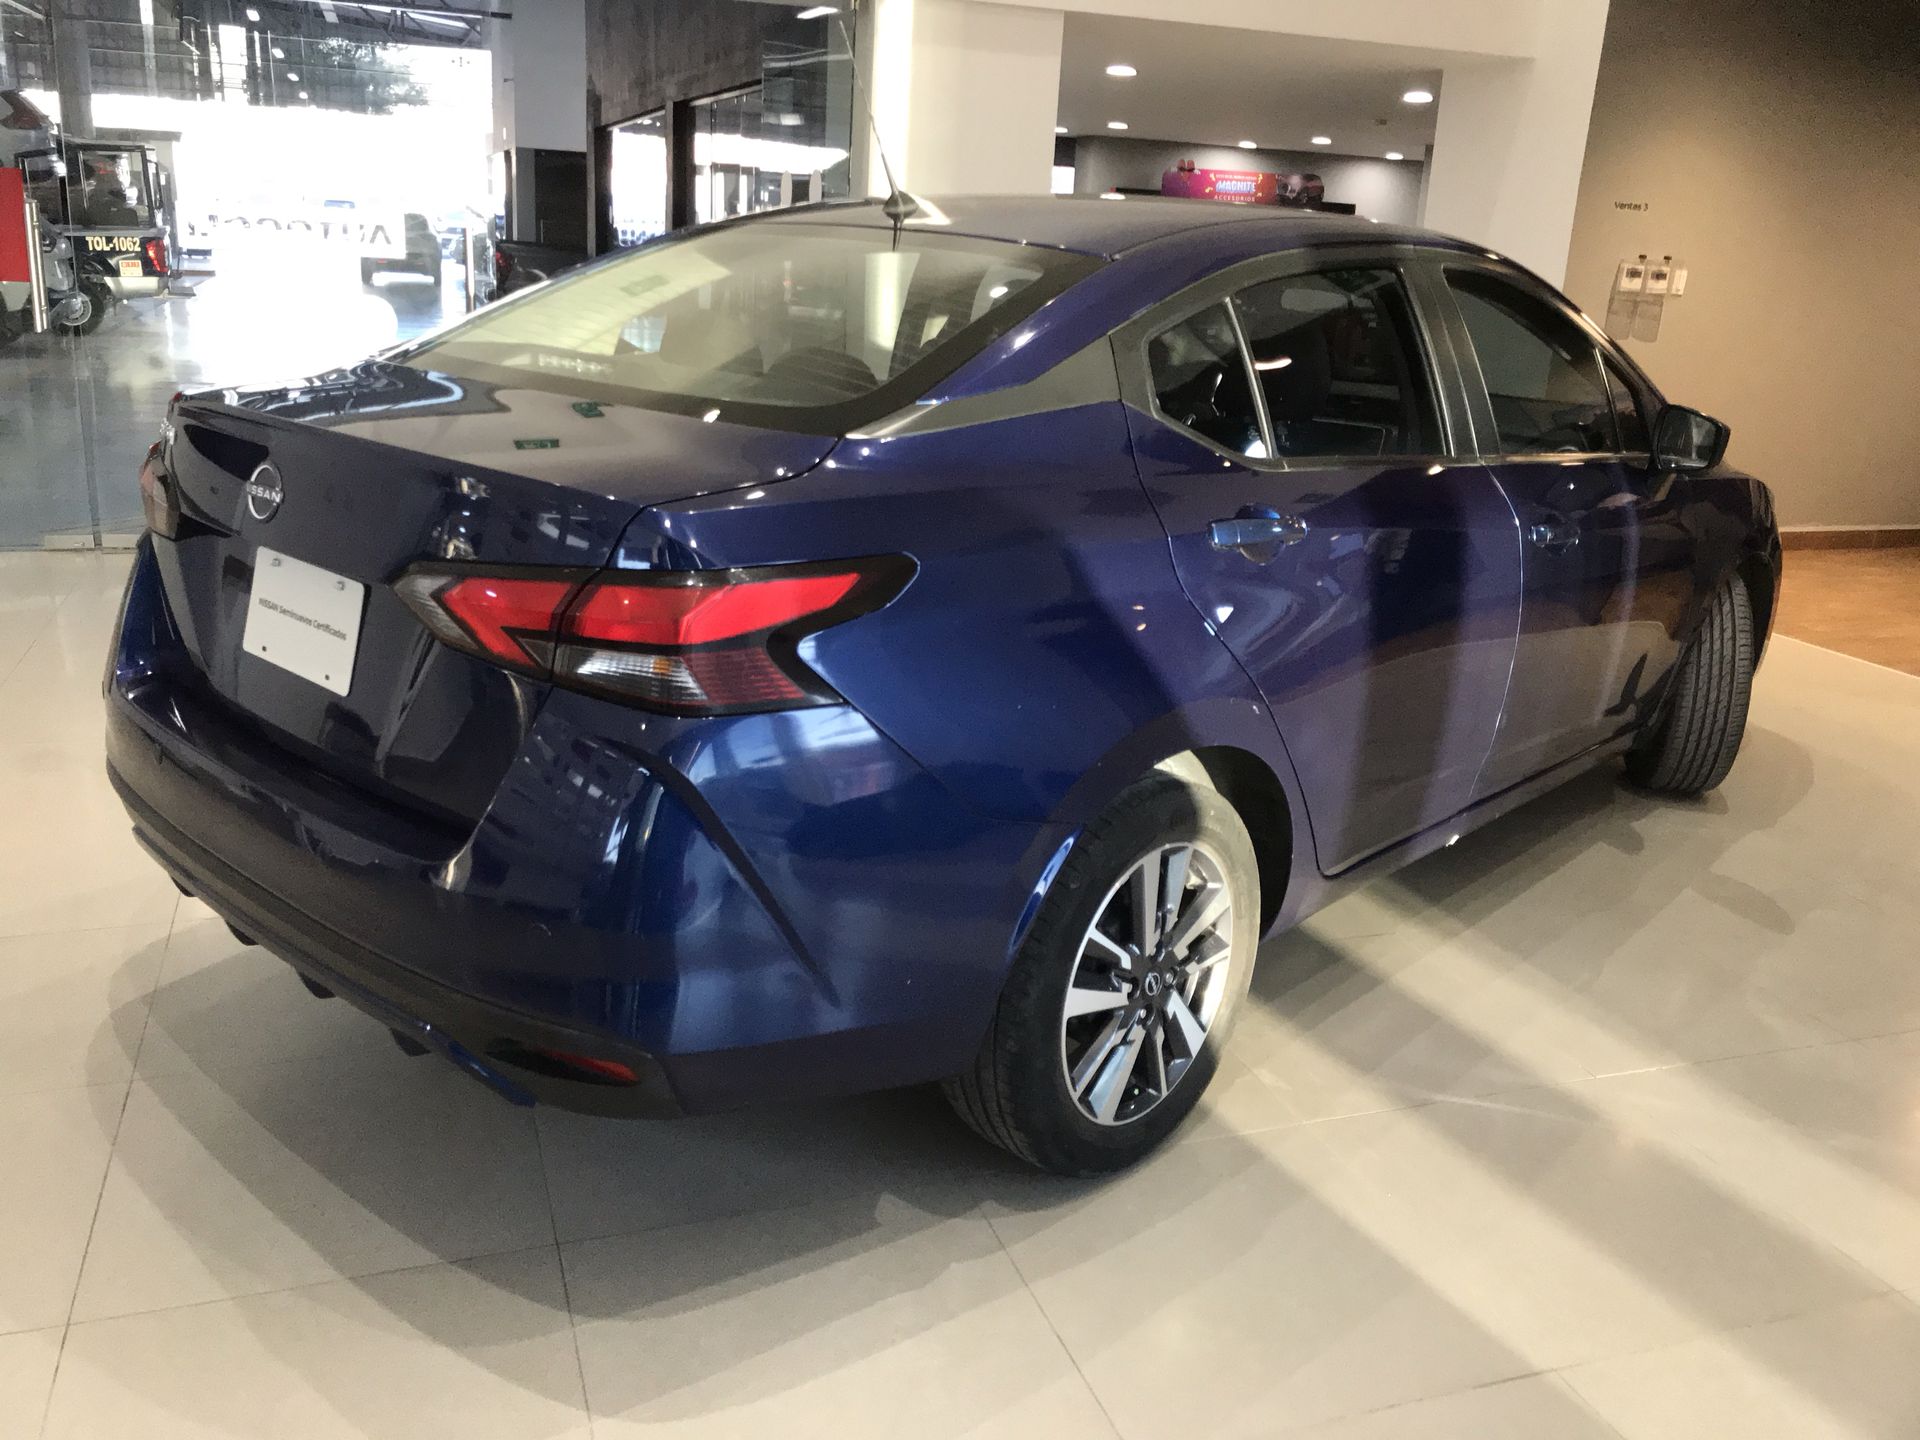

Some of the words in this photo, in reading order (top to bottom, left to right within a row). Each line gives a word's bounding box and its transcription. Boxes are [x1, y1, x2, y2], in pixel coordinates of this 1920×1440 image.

[1216, 180, 1256, 193] MAGNITE
[1614, 201, 1642, 211] Ventas
[85, 236, 141, 252] TOL-1062
[247, 482, 282, 503] SSAN
[258, 598, 279, 612] NISSAN
[279, 605, 313, 627] Seminuevos
[312, 619, 347, 641] Certificados
